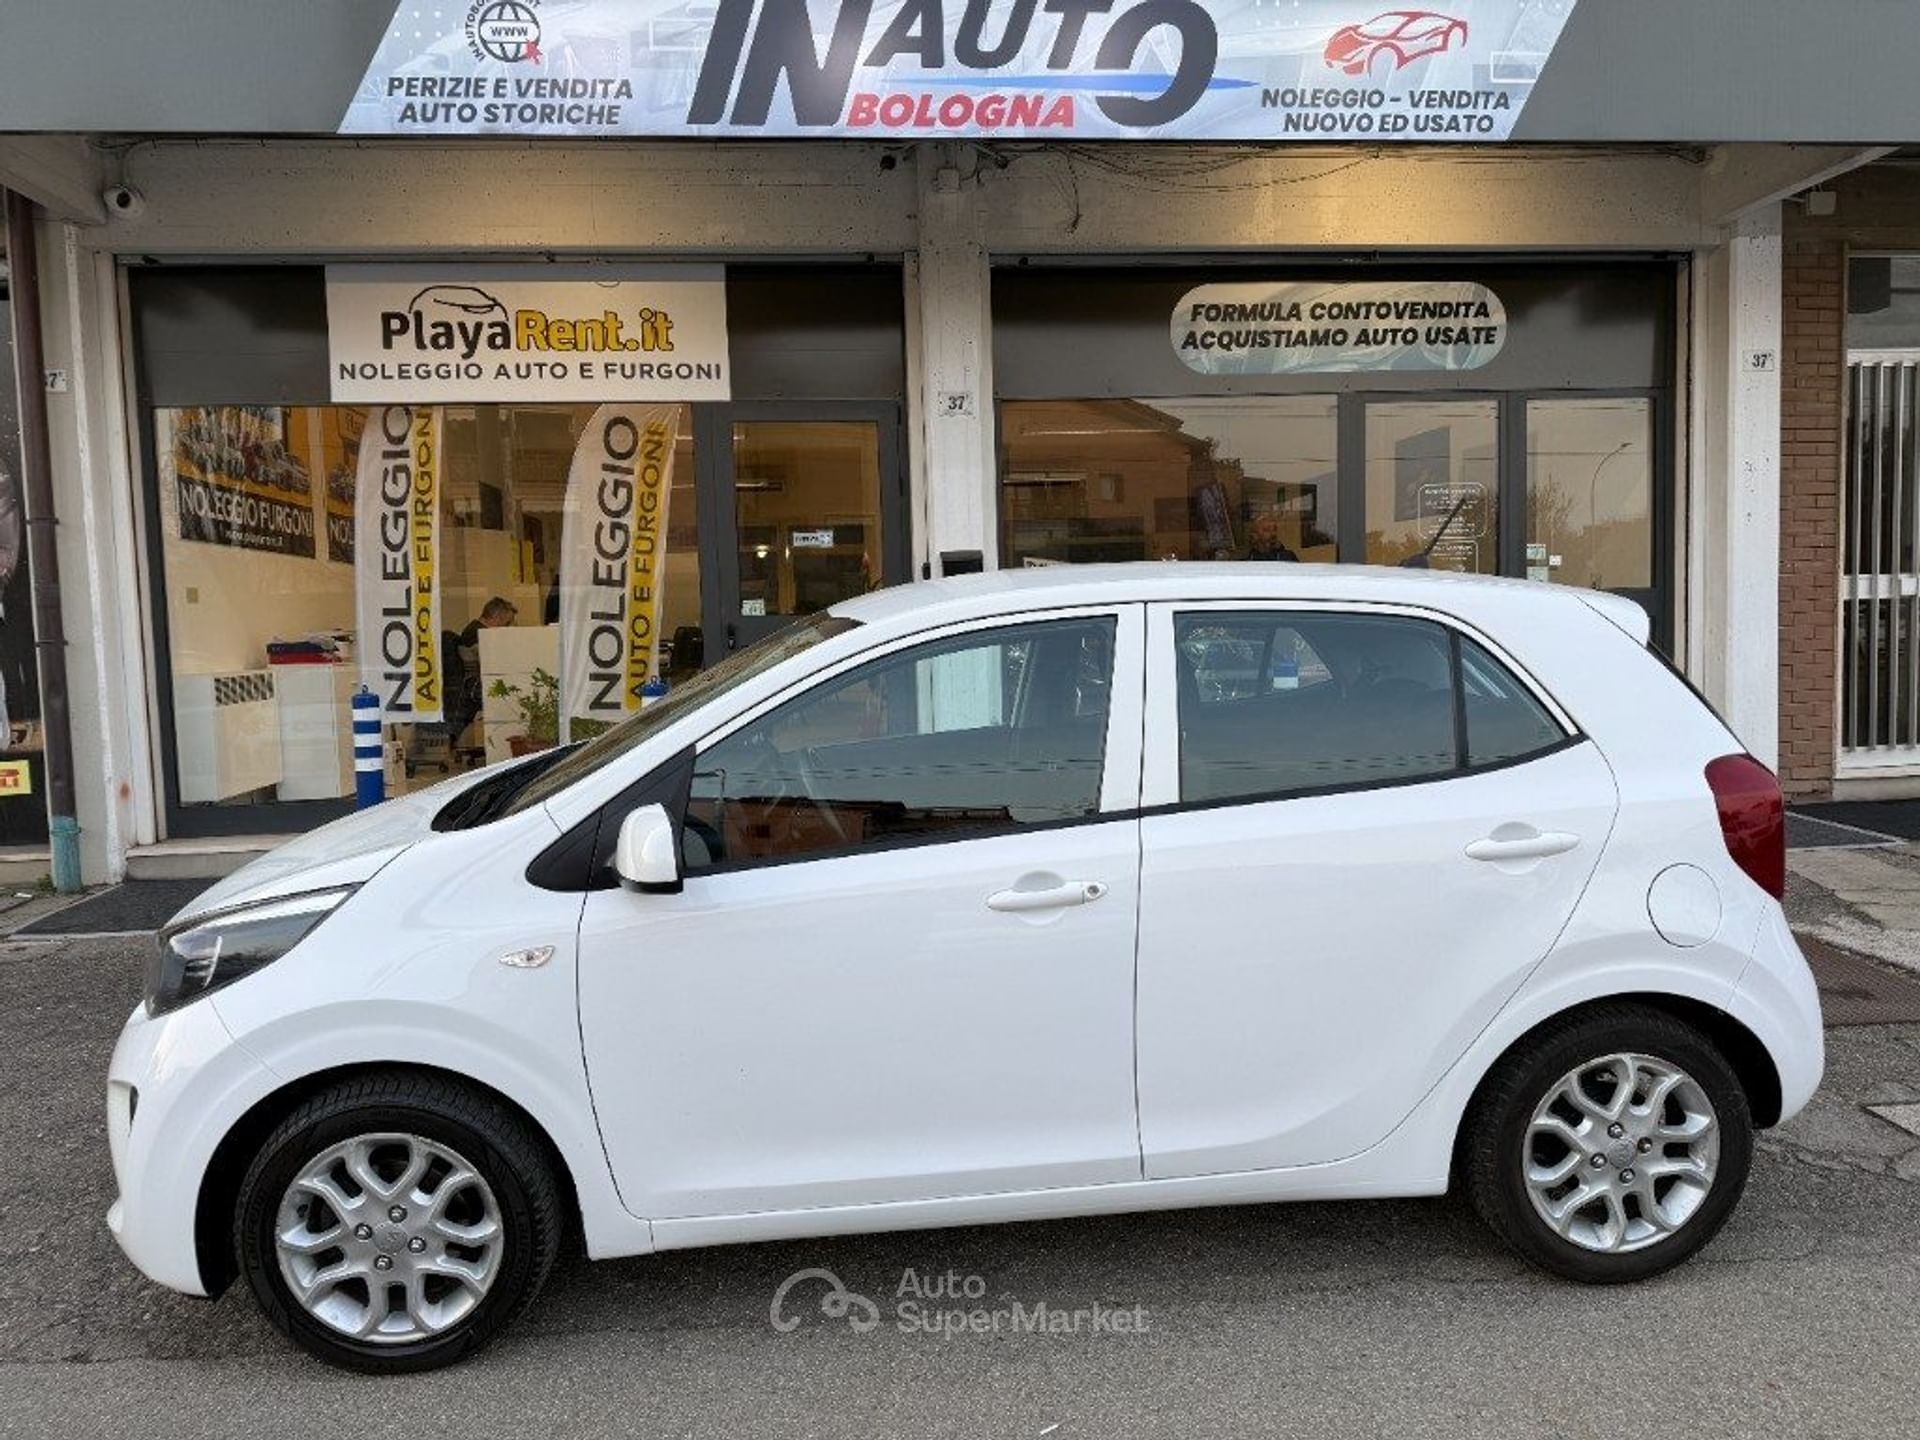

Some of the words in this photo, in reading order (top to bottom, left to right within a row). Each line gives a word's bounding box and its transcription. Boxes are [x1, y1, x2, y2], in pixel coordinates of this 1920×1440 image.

[387, 77, 487, 99] PERIZIE
[493, 78, 509, 98] E
[515, 79, 633, 99] VENDITA
[1261, 89, 1384, 109] NOLEGGIO
[1408, 90, 1510, 110] VENDITA
[398, 103, 478, 124] AUTO
[484, 104, 620, 125] STORICHE
[847, 93, 1074, 128] BOLOGNA
[1284, 111, 1375, 132] NUOVO
[1379, 112, 1408, 132] ED
[1413, 113, 1495, 133] USATO
[1191, 303, 1302, 322] FORMULA
[1309, 302, 1490, 321] CONTOVENDITA
[381, 307, 675, 359] PlayaRent.it
[1182, 326, 1348, 350] ACQUISTIAMO
[1354, 327, 1420, 347] AUTO
[1424, 326, 1497, 346] USATE
[339, 363, 483, 381] NOLEGGIO
[494, 363, 568, 380] AUTO
[580, 363, 594, 380] E
[604, 363, 721, 381] FURGONI
[414, 405, 434, 562] FURGON
[181, 483, 257, 528] NOLEGGIO
[260, 501, 314, 538] FURGONI
[381, 404, 413, 713] NOLEGGIO
[588, 416, 639, 711] NOLEGGIO
[418, 575, 432, 593] E
[634, 585, 650, 602] E
[415, 606, 438, 702] AUTO
[629, 614, 651, 702] AUTO
